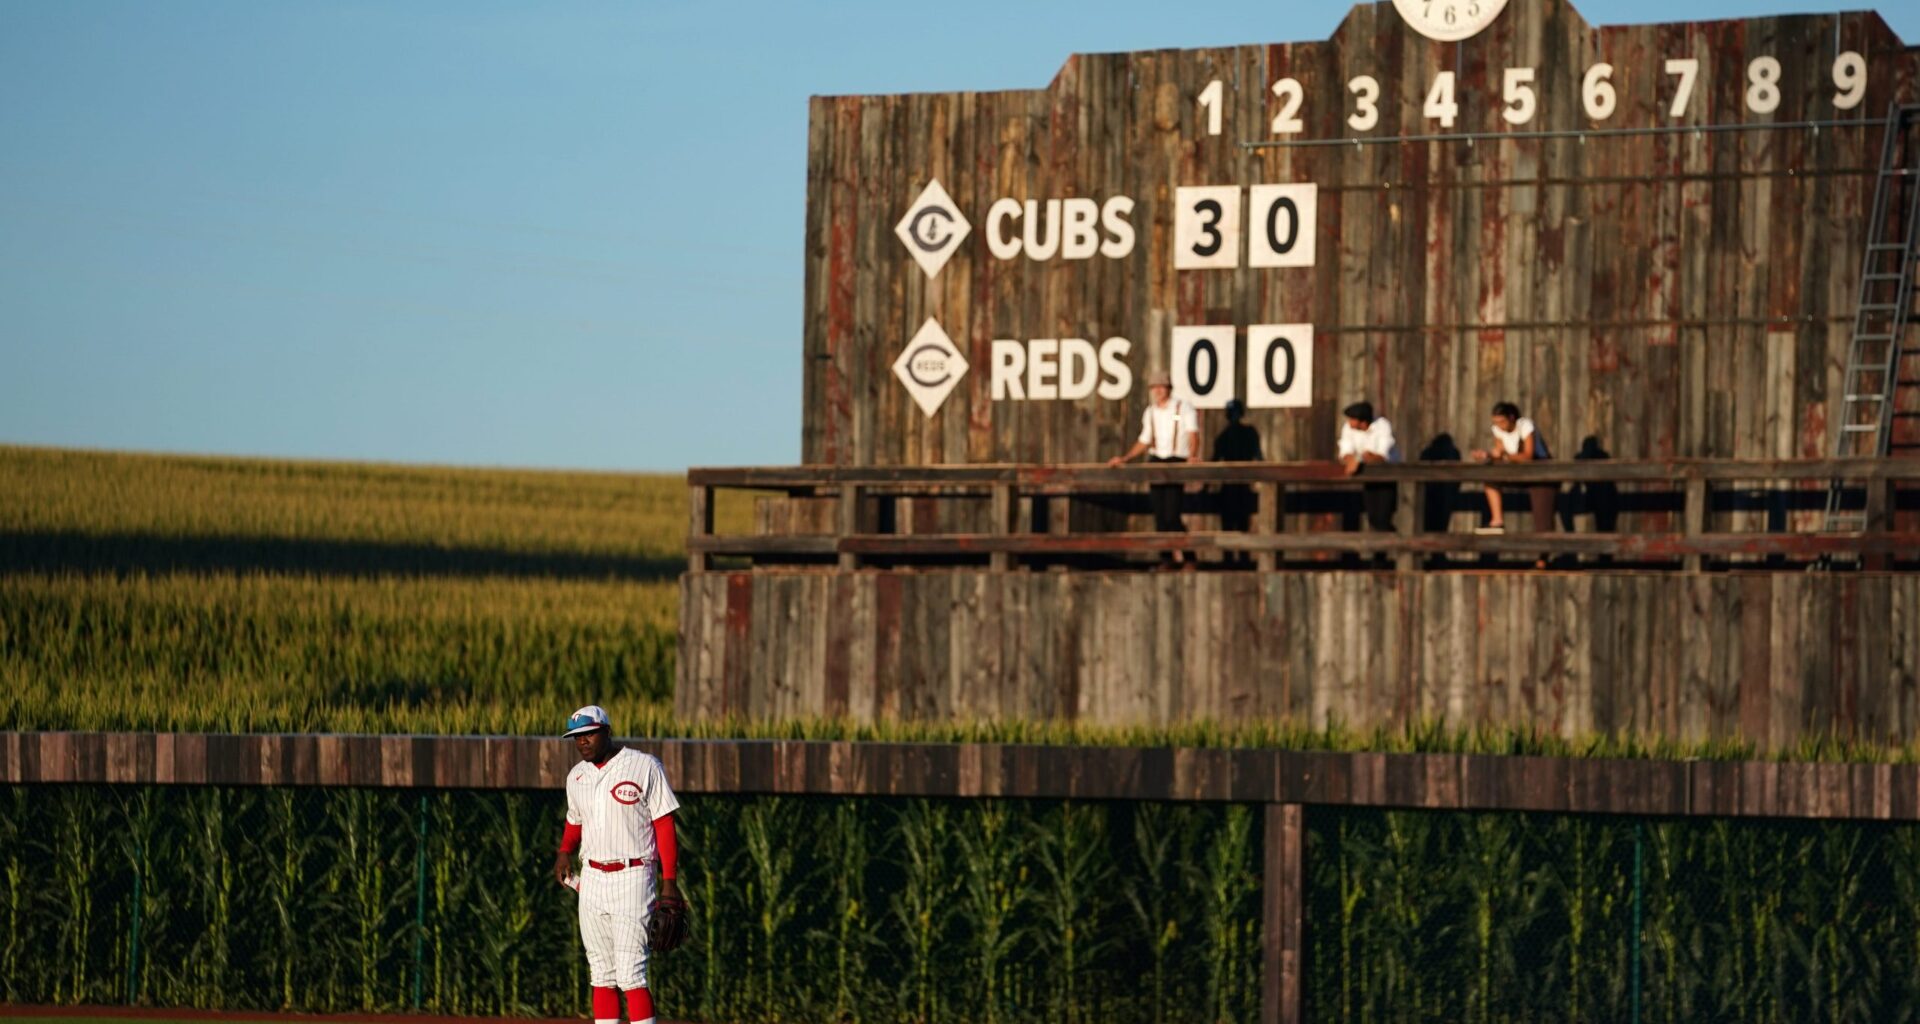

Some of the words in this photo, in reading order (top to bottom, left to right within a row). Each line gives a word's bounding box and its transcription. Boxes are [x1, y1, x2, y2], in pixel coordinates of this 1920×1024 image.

[1422, 0, 1432, 18] 7
[1444, 6, 1456, 24] 6
[1197, 80, 1223, 135] 1
[1271, 78, 1304, 133] 2
[1347, 75, 1380, 131] 3
[1423, 71, 1458, 127] 4
[1502, 67, 1536, 124] 5
[1582, 62, 1617, 120] 6
[1665, 59, 1699, 117] 7
[1746, 56, 1781, 113] 8
[1832, 51, 1867, 109] 9
[986, 196, 1135, 261] CUBS
[1191, 199, 1223, 257] 3
[1266, 196, 1299, 254] 0
[991, 337, 1132, 401] REDS
[1188, 338, 1218, 396] 0
[1264, 337, 1296, 394] 0
[618, 789, 638, 798] REDS
